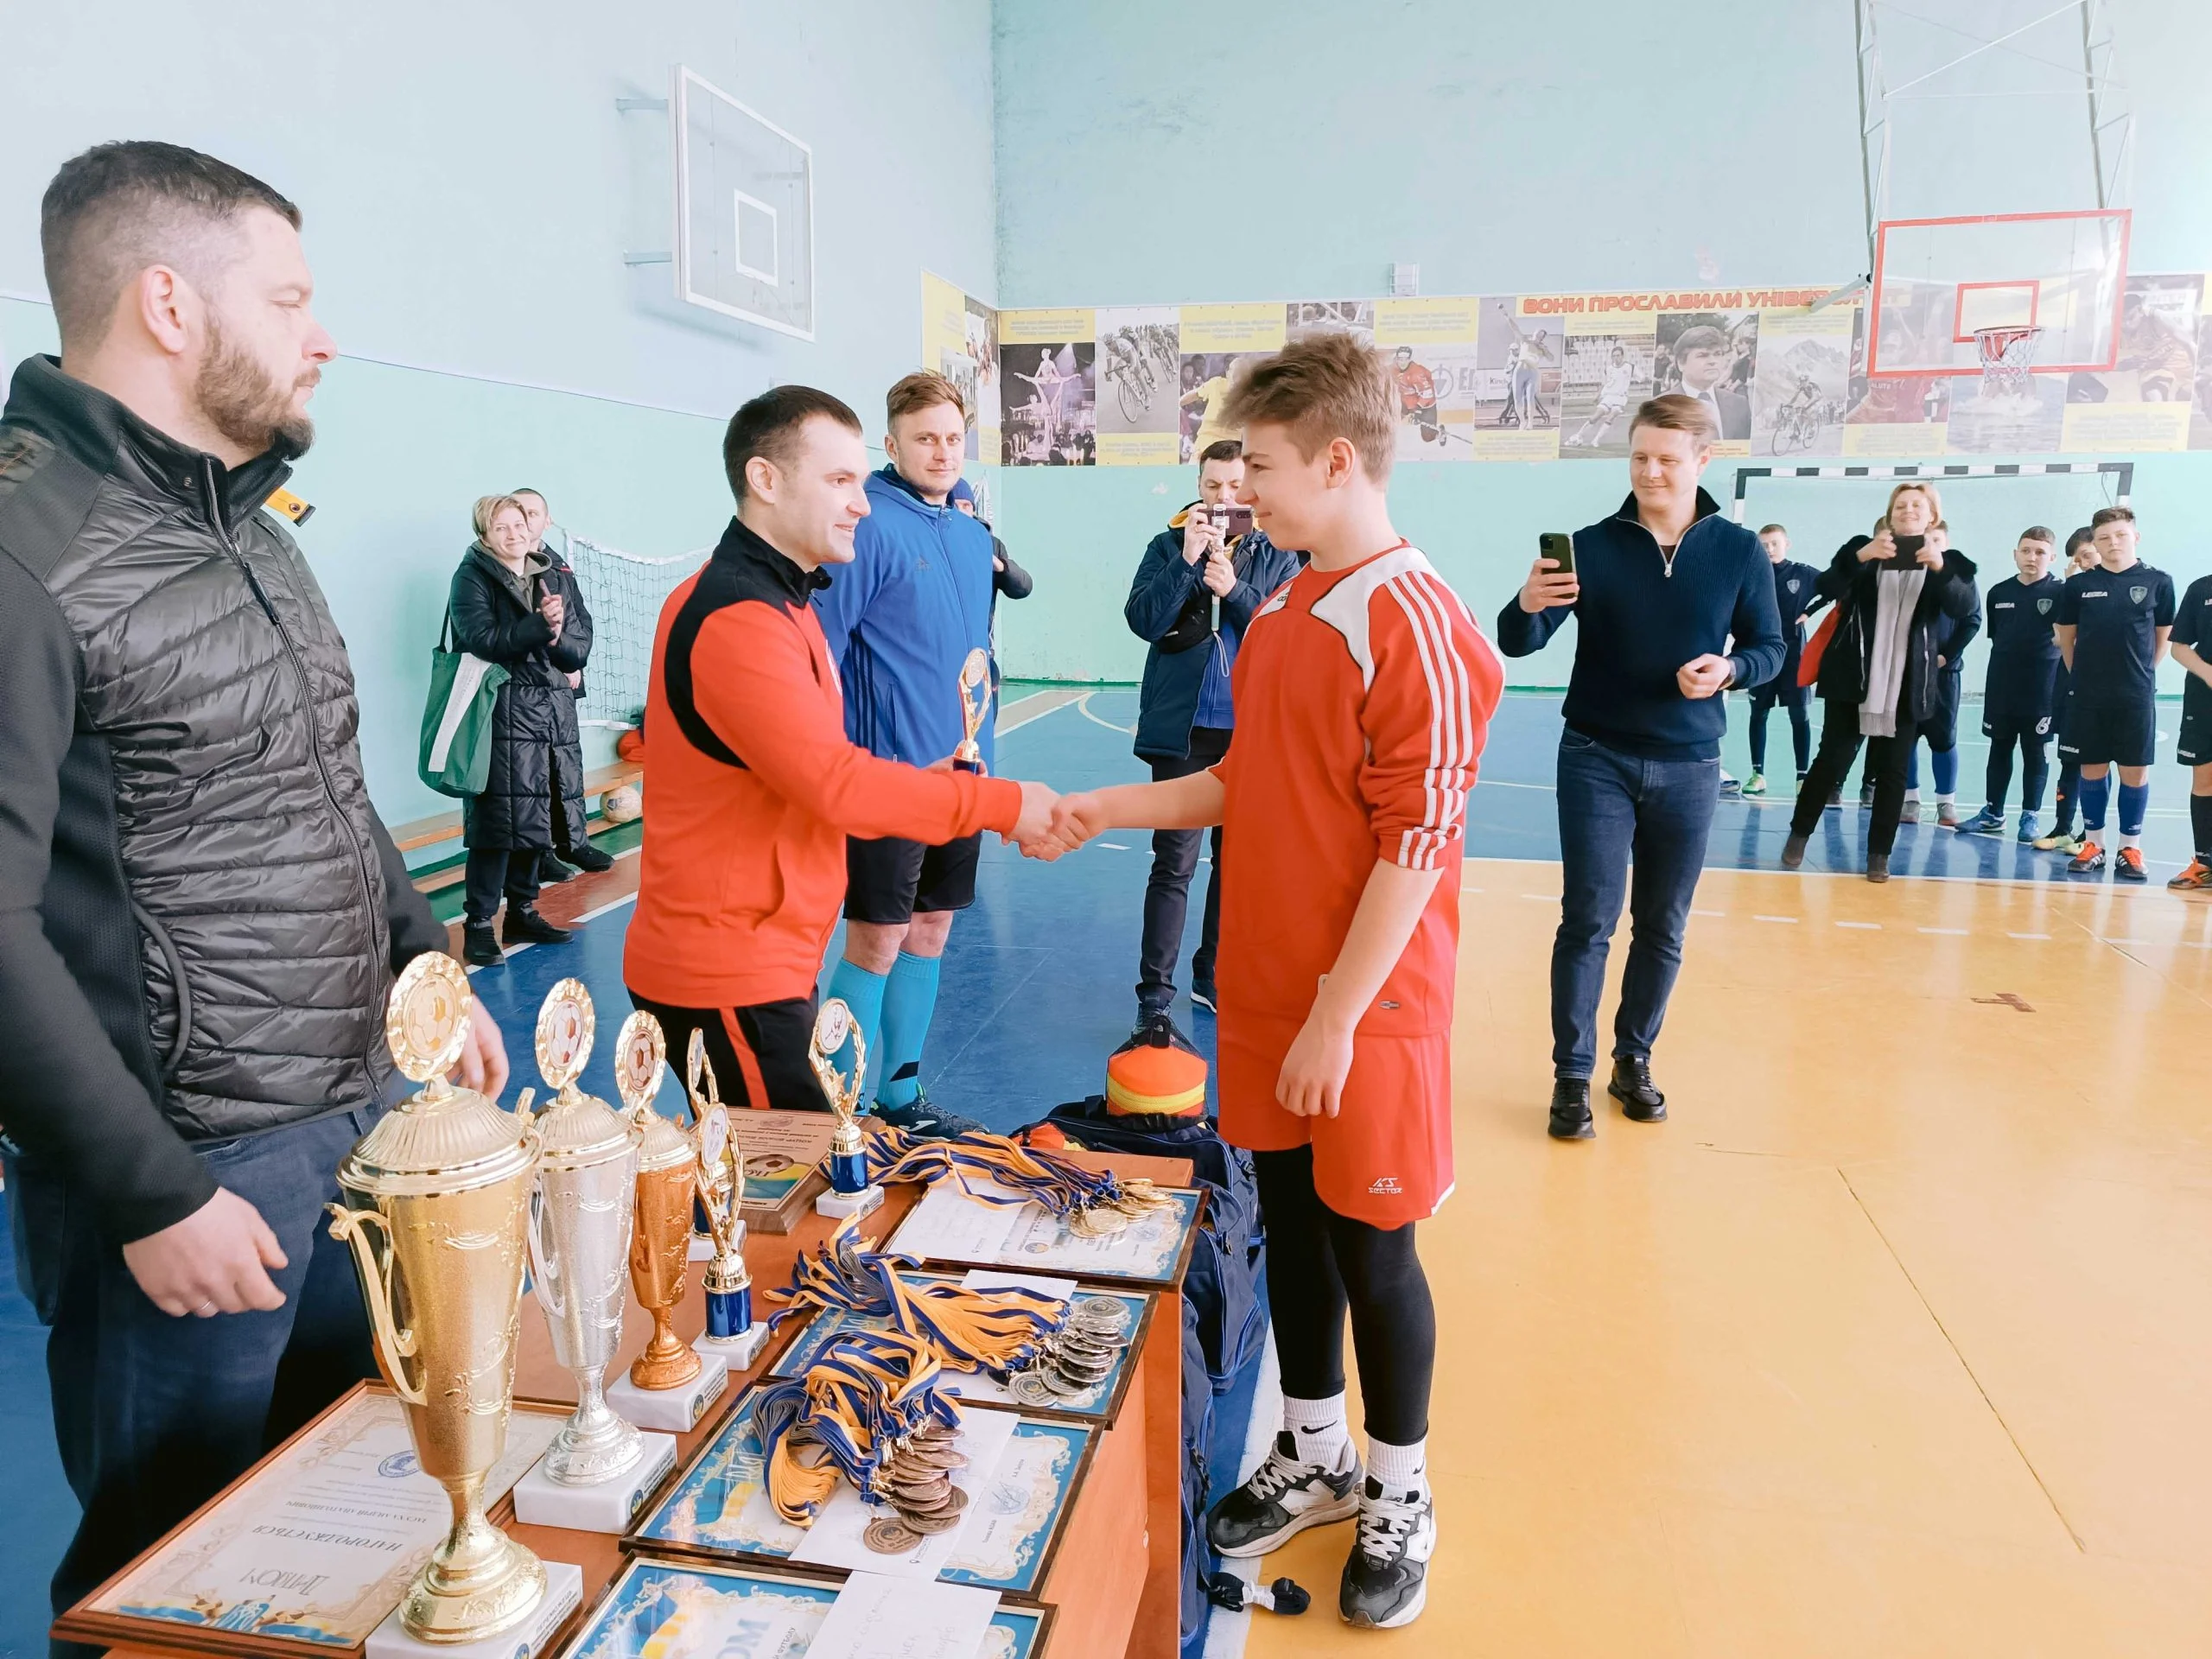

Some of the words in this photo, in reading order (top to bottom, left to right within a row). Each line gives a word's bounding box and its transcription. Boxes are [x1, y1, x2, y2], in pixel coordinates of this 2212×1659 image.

[1523, 298, 1585, 314] ВОНИ
[1589, 292, 1743, 312] ПРОСЛАВИЛИ
[252, 1523, 404, 1553] НАГОРОДЖУЄТЬСЯ
[238, 1567, 331, 1596] ДИПЛОМ
